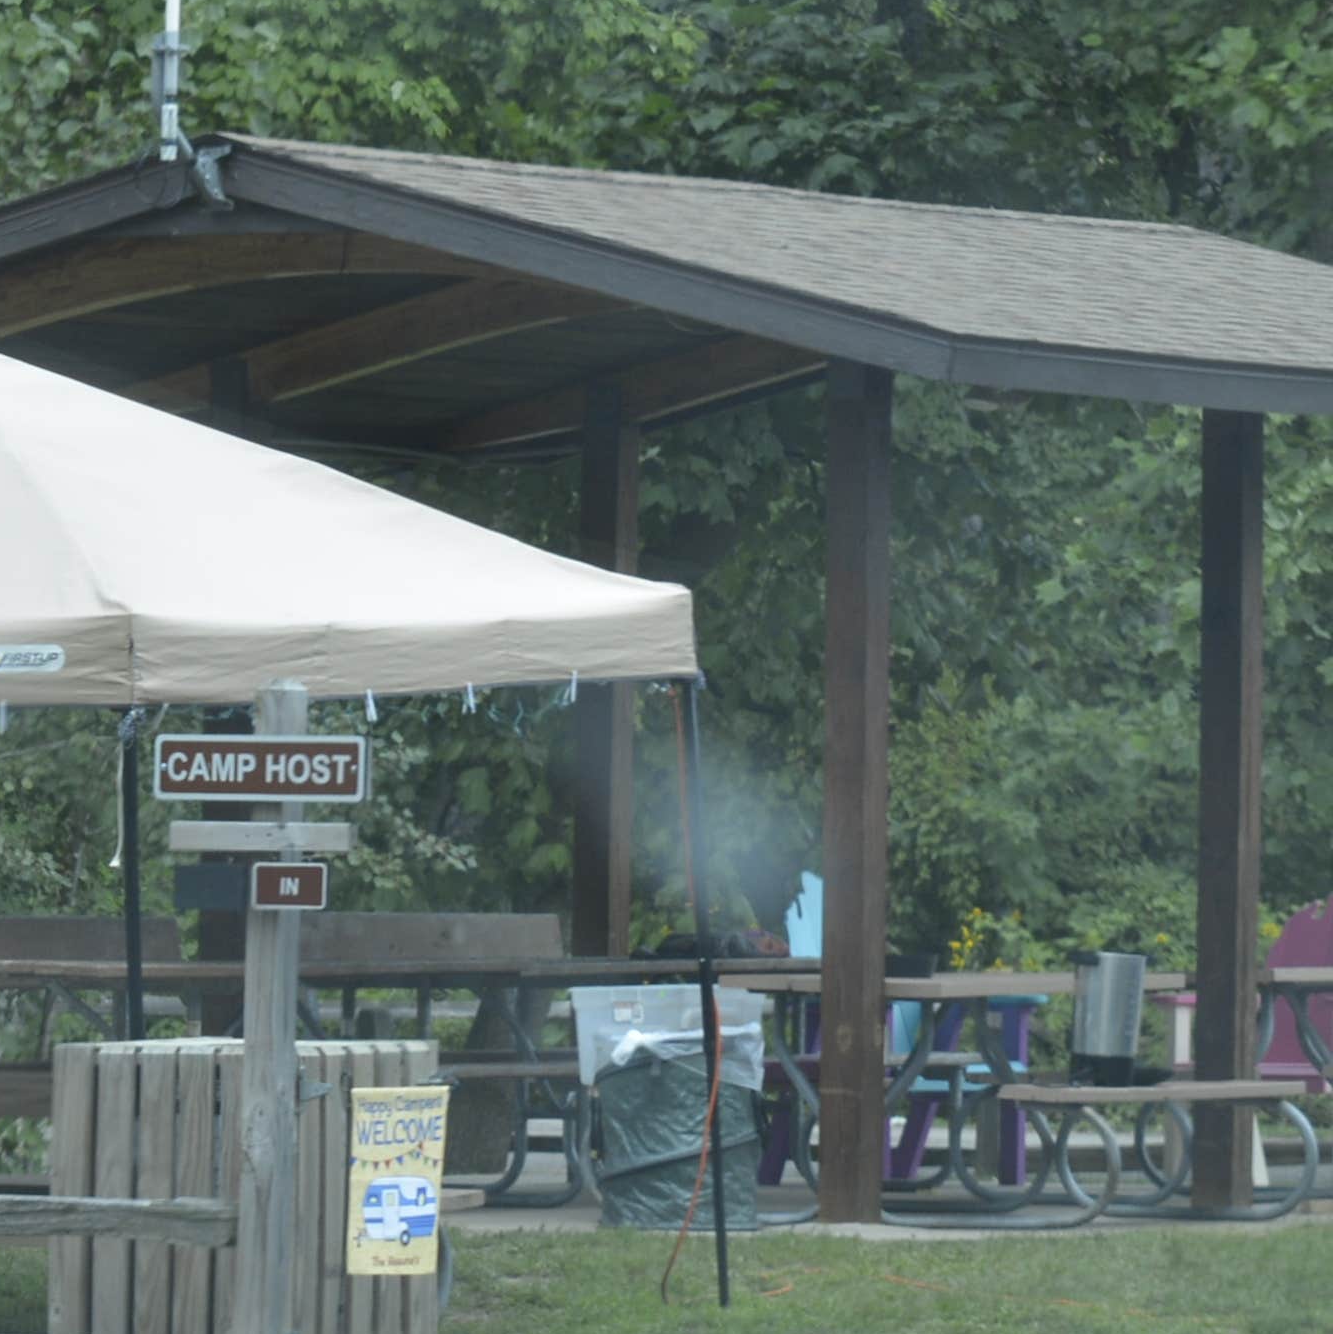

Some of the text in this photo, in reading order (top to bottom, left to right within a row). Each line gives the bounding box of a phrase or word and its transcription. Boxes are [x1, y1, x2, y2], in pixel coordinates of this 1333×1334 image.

[166, 751, 353, 784] CAMP HOST
[279, 877, 300, 896] IN
[356, 1097, 393, 1117] Happy
[356, 1115, 444, 1145] WELCOME
